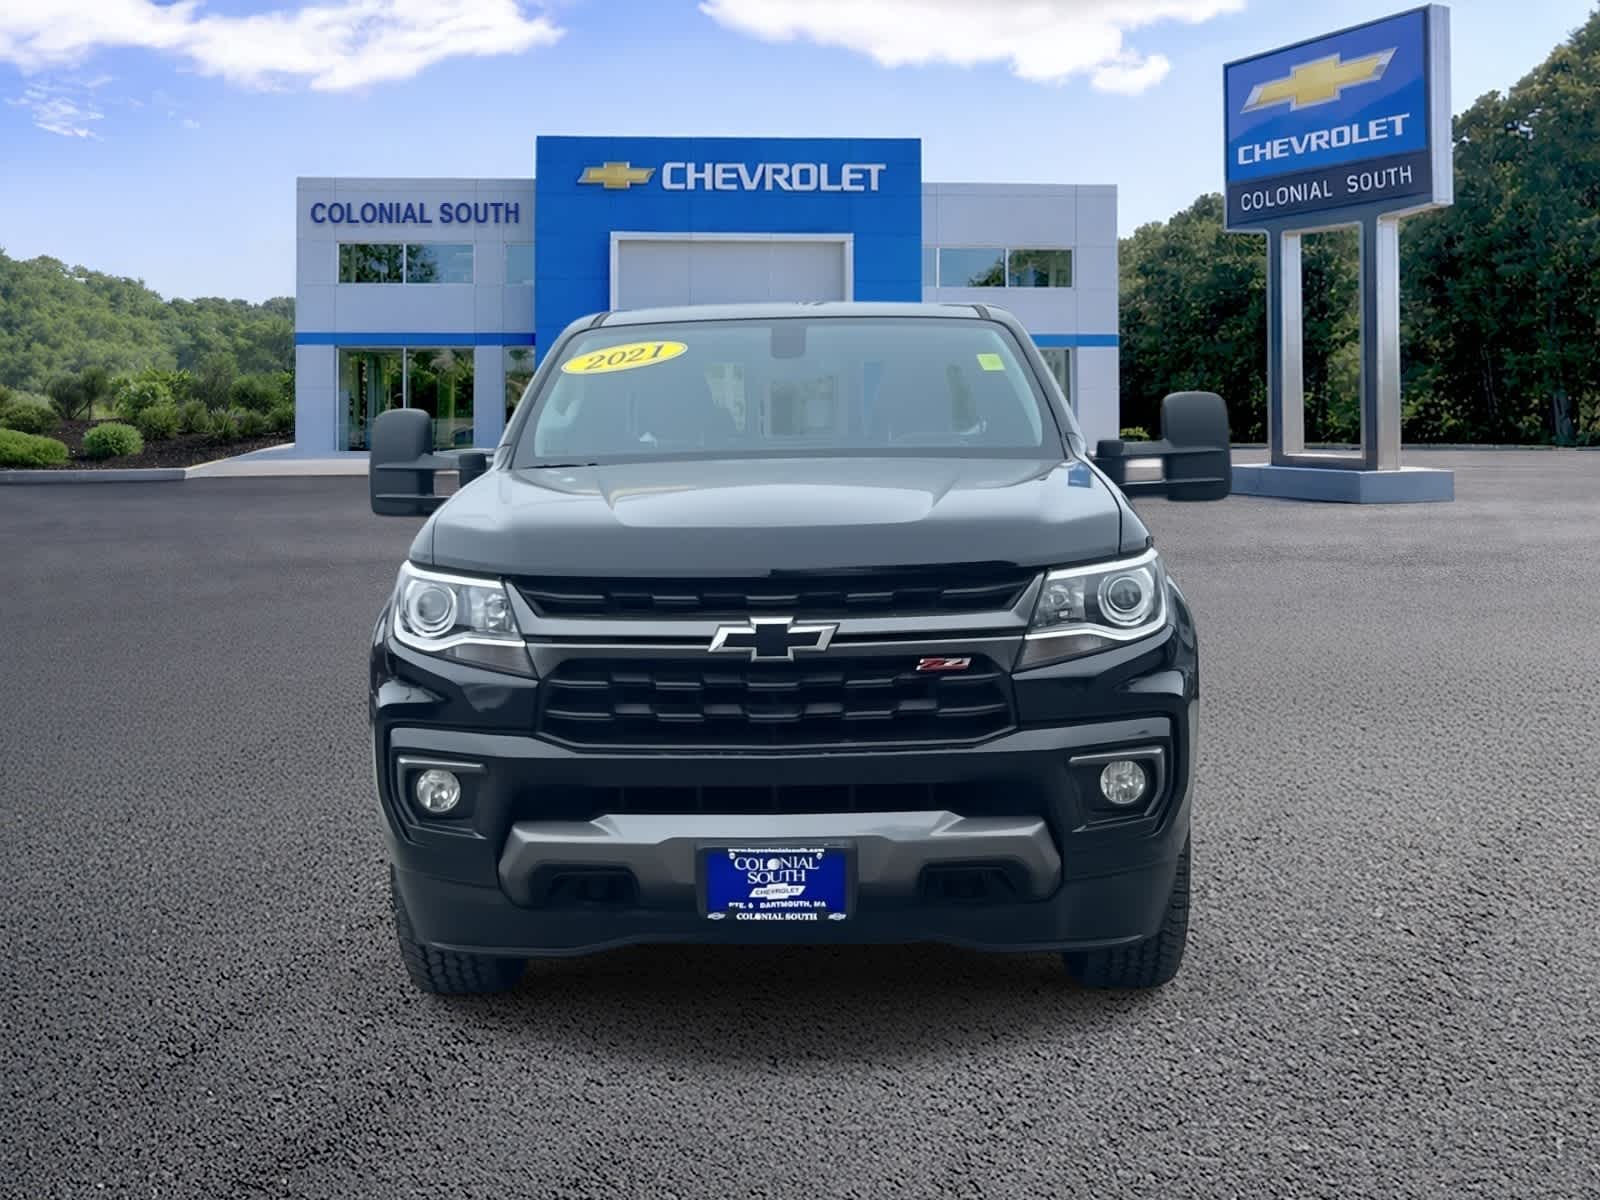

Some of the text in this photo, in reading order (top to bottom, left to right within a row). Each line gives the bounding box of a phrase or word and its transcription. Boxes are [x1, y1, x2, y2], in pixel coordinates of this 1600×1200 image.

[1237, 113, 1410, 165] CHEVROLET
[662, 162, 887, 191] CHEVROLET
[1240, 165, 1412, 212] COLONIAL SOUTH
[310, 202, 520, 224] COLONIAL SOUTH
[584, 343, 665, 371] 2021
[734, 856, 819, 872] COLONIAL
[747, 869, 807, 884] SOUTH
[755, 886, 800, 896] CHEVROLET
[736, 912, 818, 921] COLONIAL SOUTH
